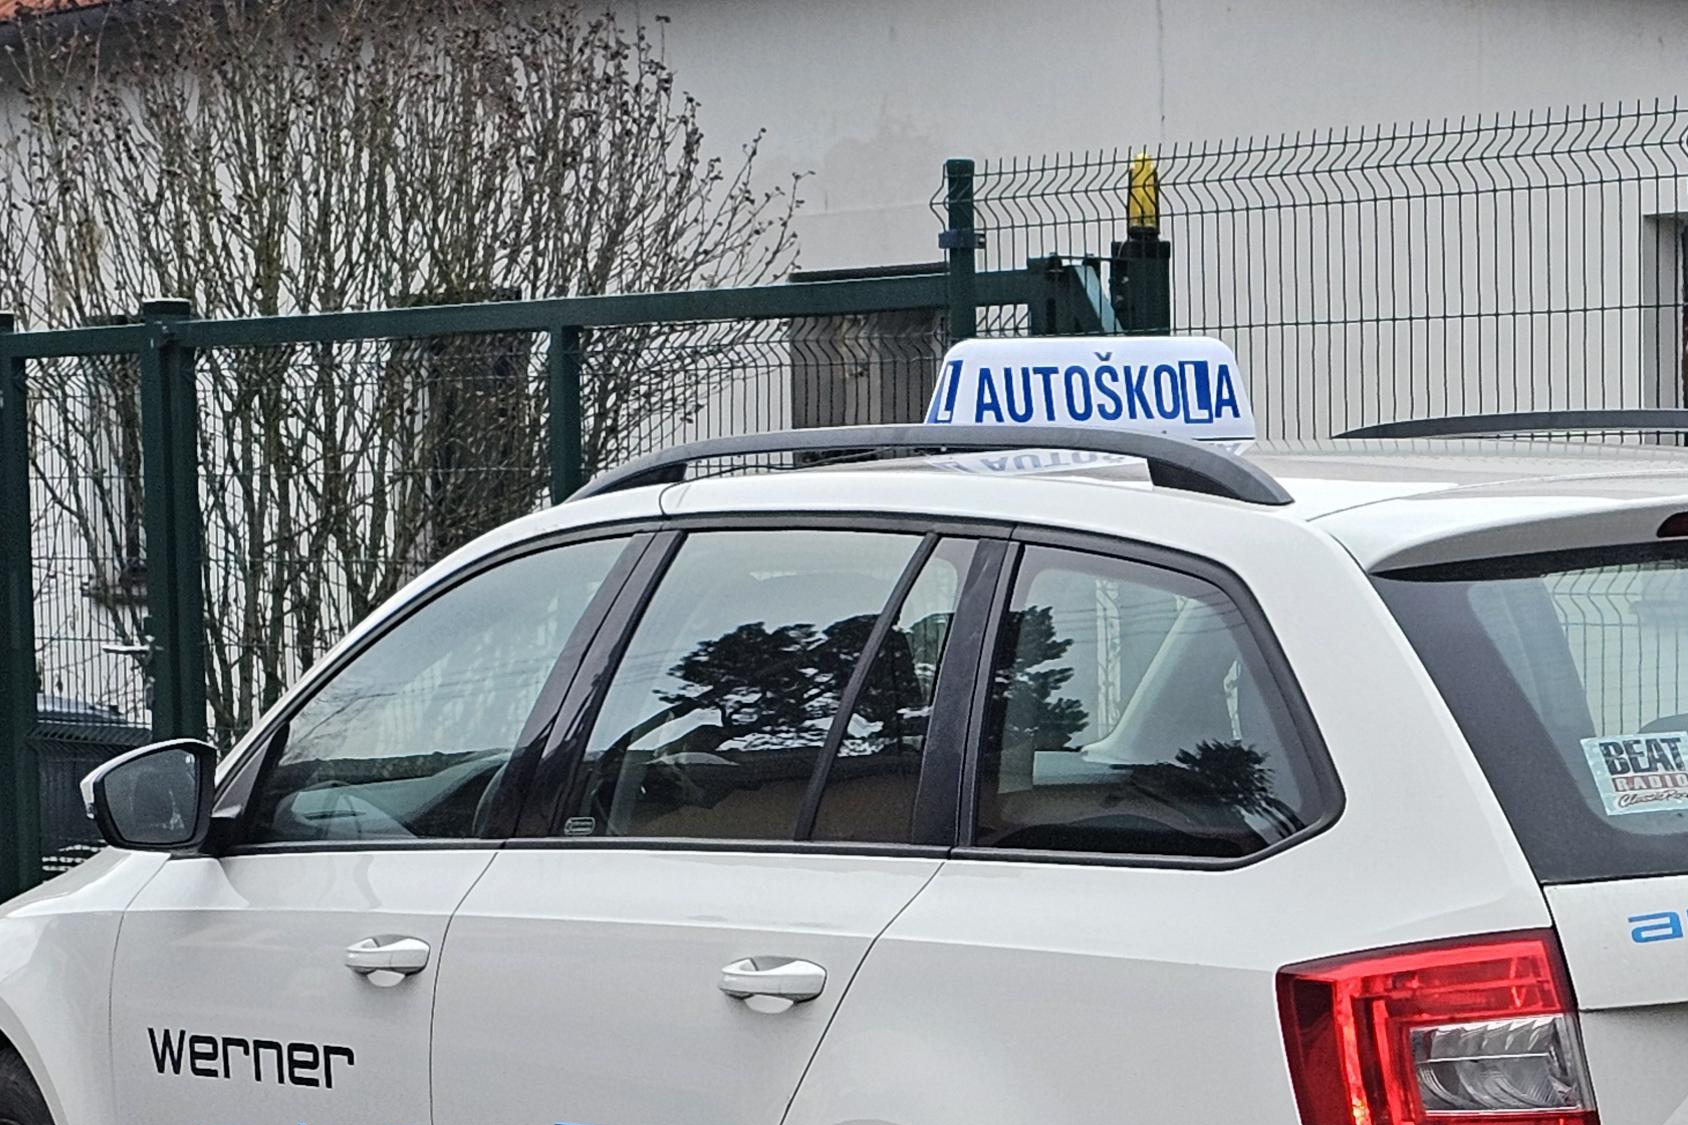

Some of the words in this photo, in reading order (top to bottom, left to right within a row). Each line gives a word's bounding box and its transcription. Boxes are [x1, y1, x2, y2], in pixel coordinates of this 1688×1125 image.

[975, 352, 1240, 424] AUTOŠKOLA
[1599, 737, 1687, 775] BEAT
[147, 1027, 354, 1088] werner
